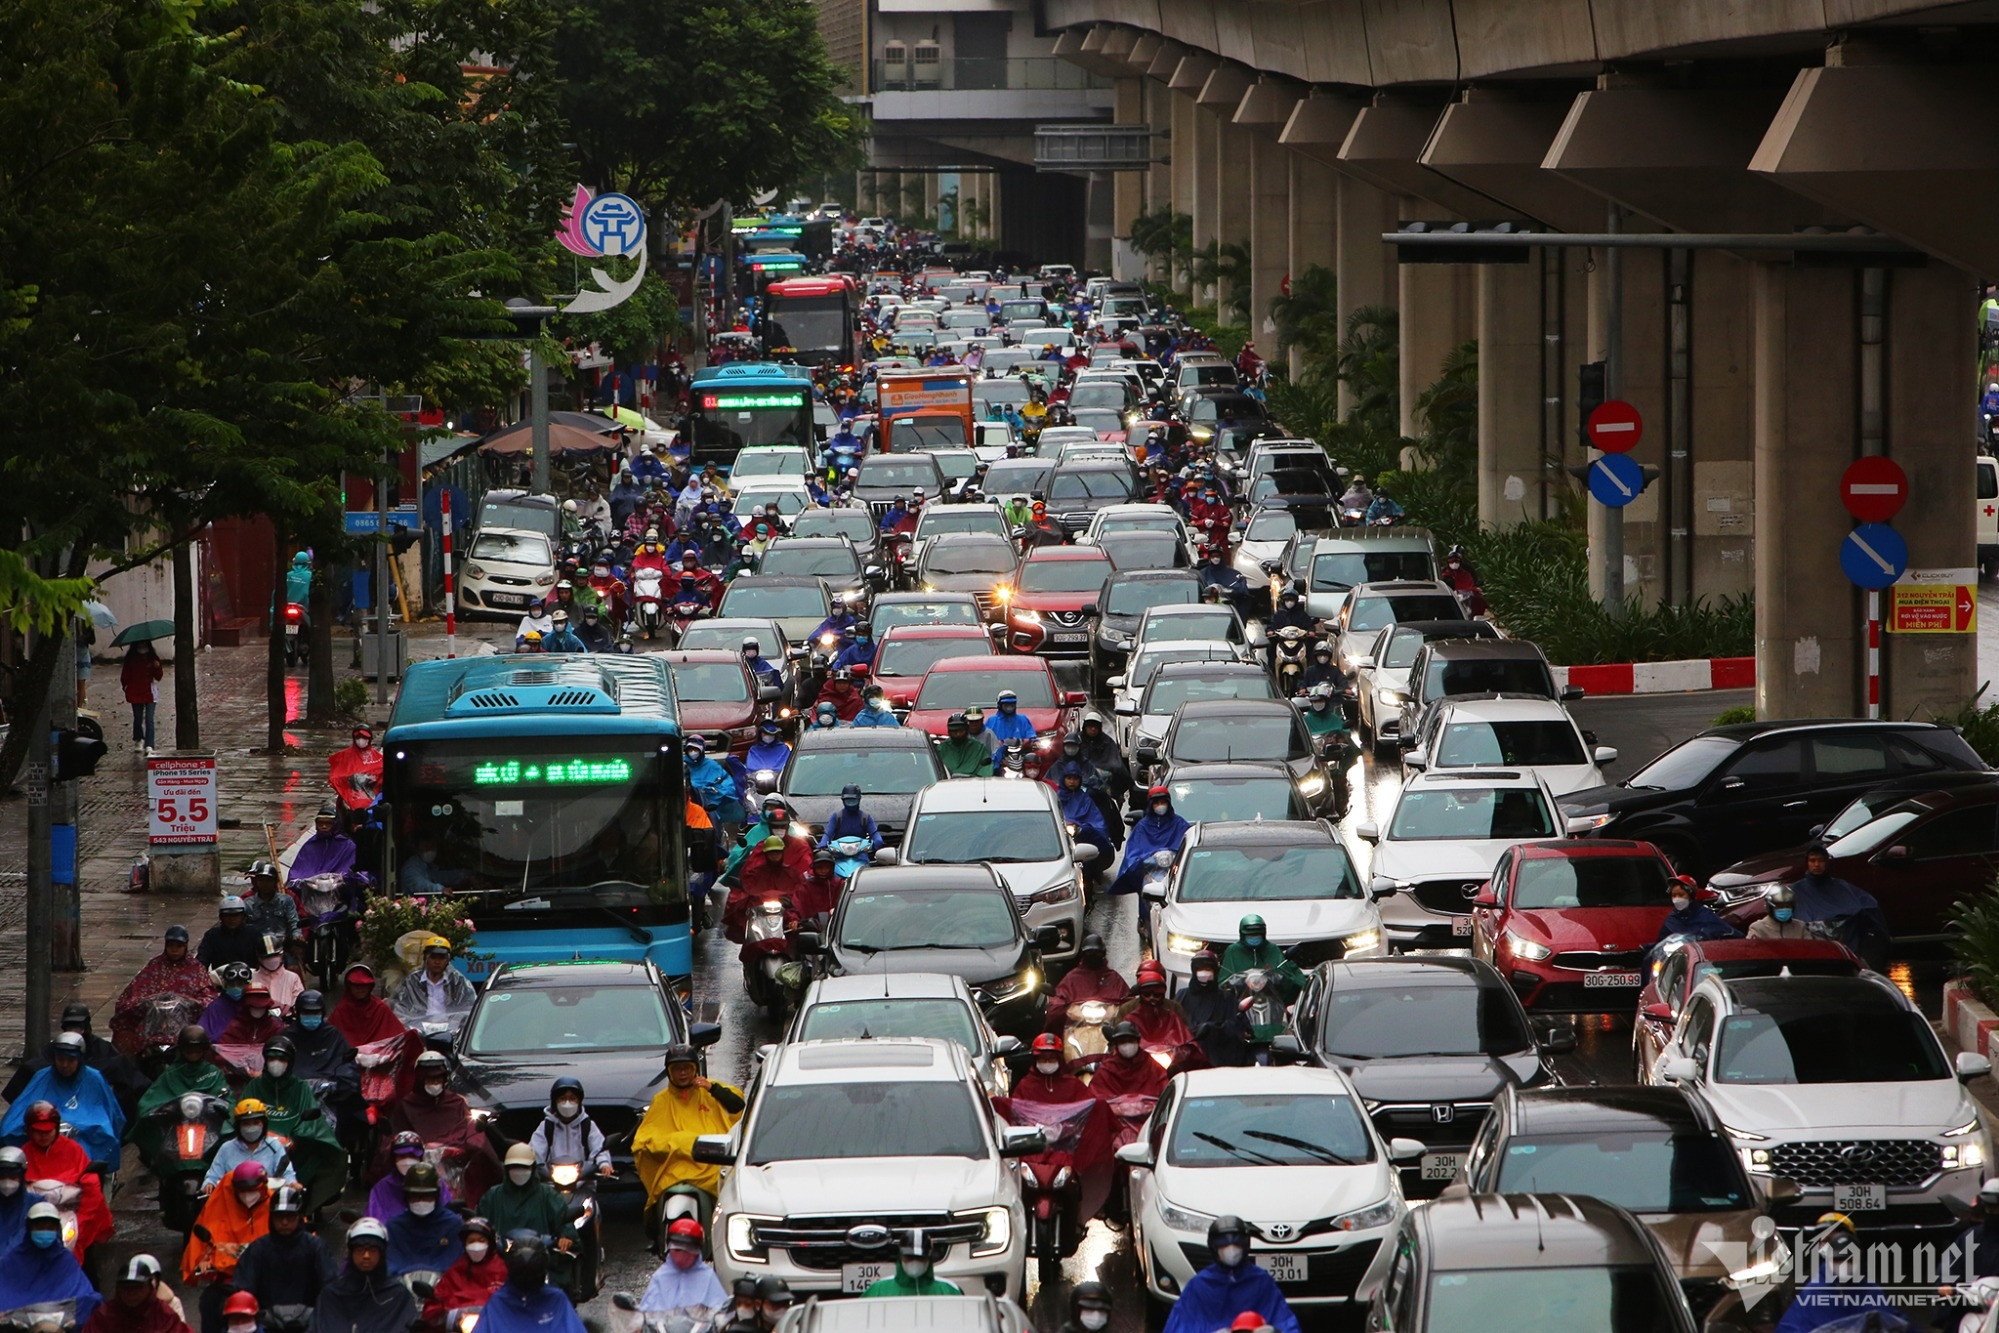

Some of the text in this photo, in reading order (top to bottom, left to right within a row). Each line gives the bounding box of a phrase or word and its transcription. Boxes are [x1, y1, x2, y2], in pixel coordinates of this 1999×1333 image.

[163, 788, 174, 796] Ưu
[157, 798, 208, 823] 5.5
[170, 823, 196, 834] Triệu
[1585, 975, 1640, 986] 30G-250.99
[1434, 1156, 1456, 1167] 30H
[1426, 1167, 1460, 1178] 202.2
[1849, 1186, 1871, 1197] 30H
[1839, 1198, 1880, 1210] 508.64
[1270, 1256, 1293, 1268] 30H
[858, 1265, 881, 1278] 30K
